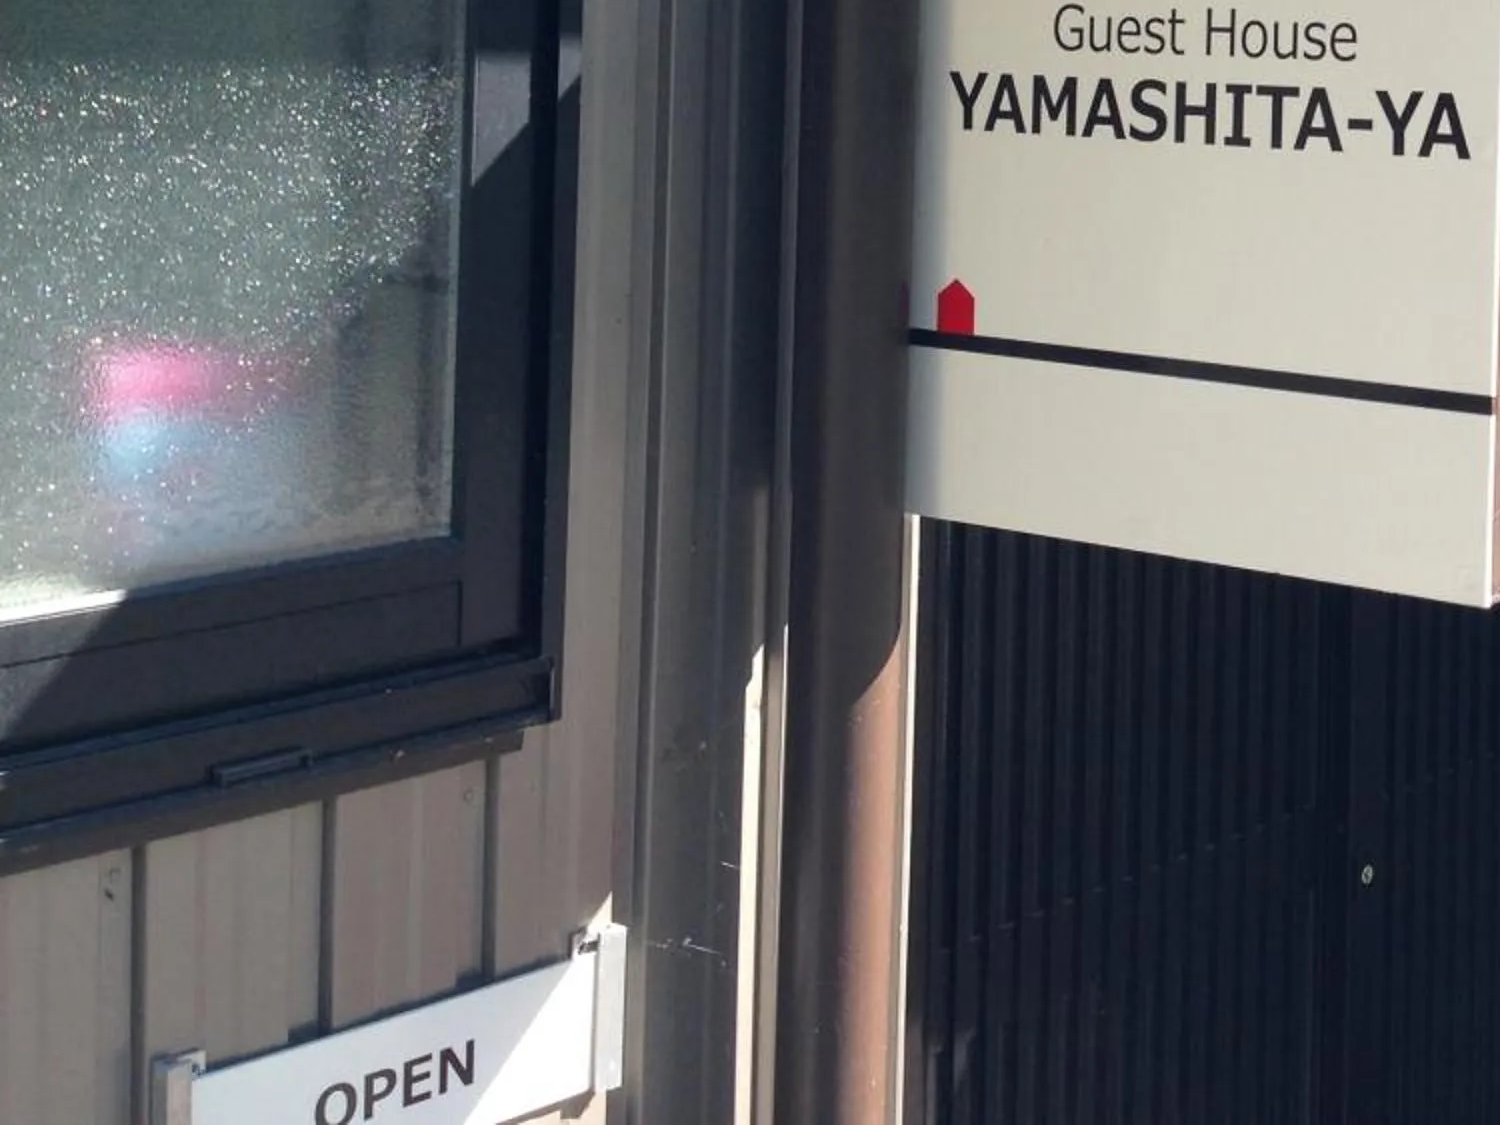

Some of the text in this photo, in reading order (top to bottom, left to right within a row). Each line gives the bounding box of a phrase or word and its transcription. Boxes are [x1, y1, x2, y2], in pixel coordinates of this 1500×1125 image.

[1053, 2, 1359, 63] Guest House
[949, 70, 1472, 161] YAMASHITA-YA
[314, 1038, 475, 1125] OPEN
